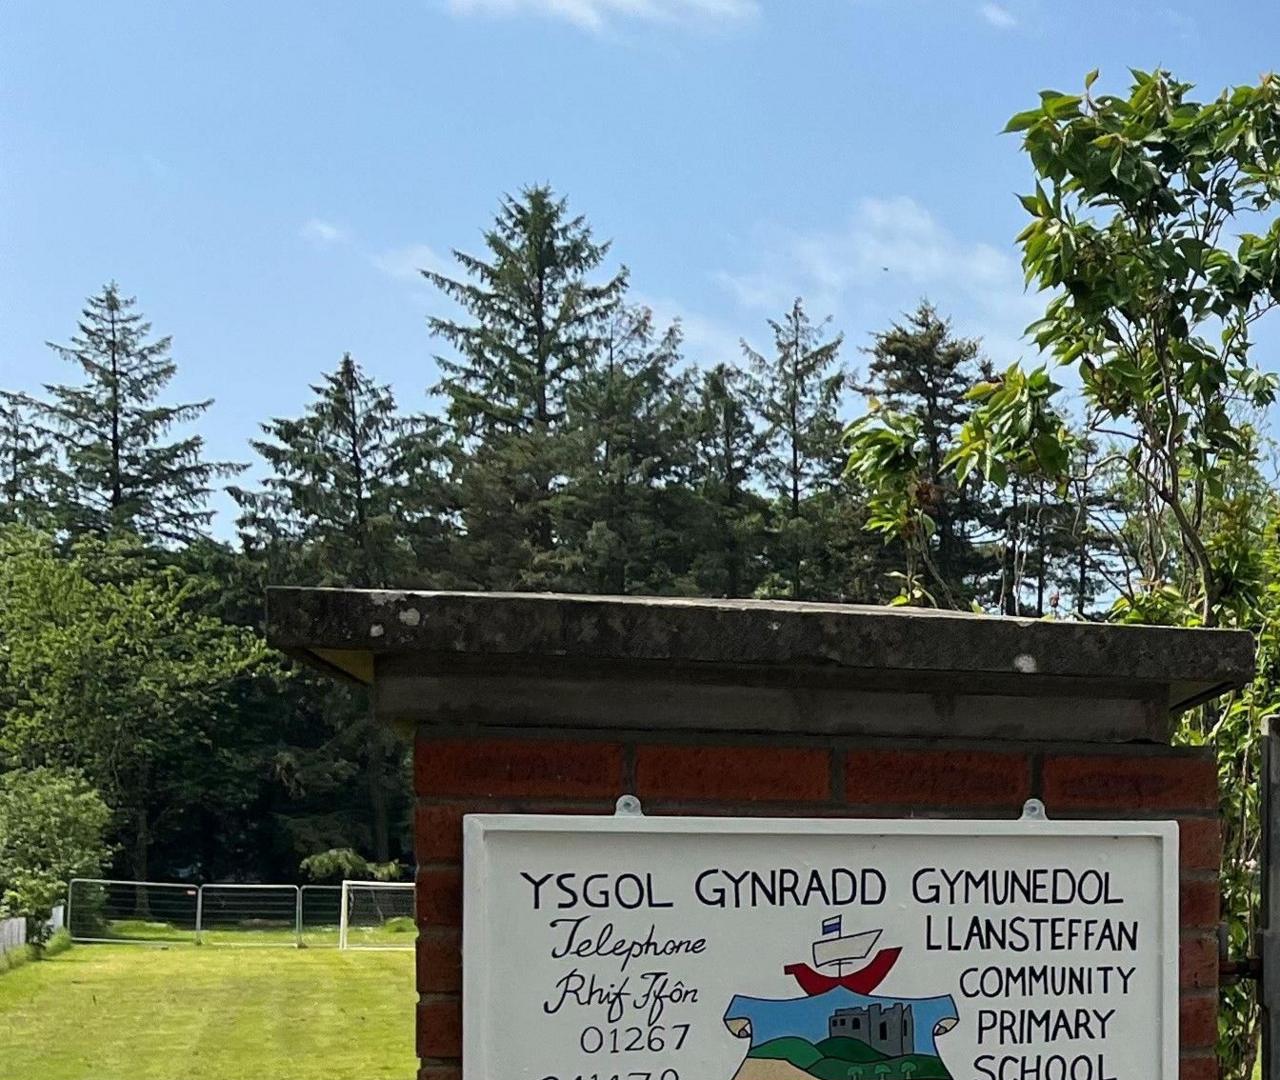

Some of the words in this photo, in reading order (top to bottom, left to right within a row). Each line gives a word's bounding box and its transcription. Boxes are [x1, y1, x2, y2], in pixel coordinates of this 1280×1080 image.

[520, 872, 673, 909] YSGOL
[695, 868, 886, 908] GYNRADD
[912, 868, 1123, 905] GYMUNEDOL
[550, 915, 707, 972] Telephone
[926, 914, 1138, 952] LLANSTEFFAN
[543, 968, 631, 1024] Rhif
[958, 965, 1136, 999] COMMUNITY
[580, 1023, 691, 1054] 01267
[977, 1009, 1115, 1045] PRIMARY
